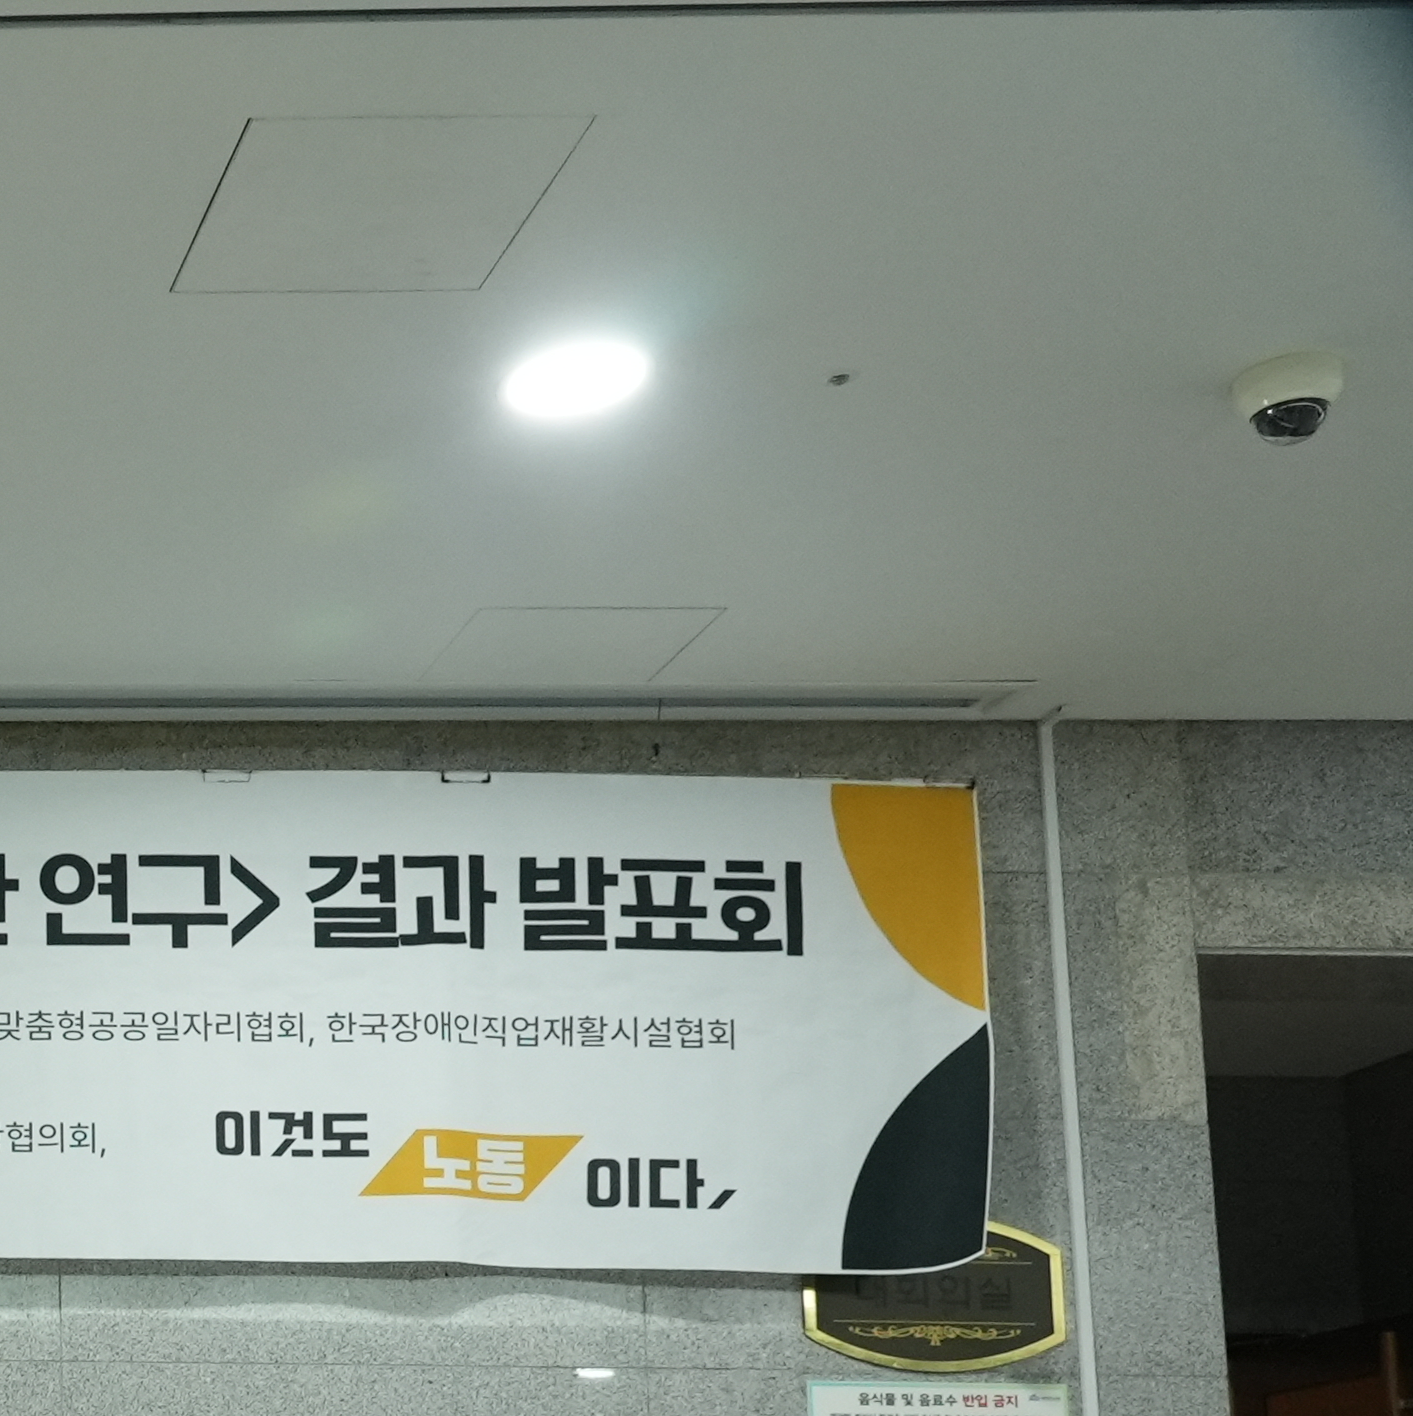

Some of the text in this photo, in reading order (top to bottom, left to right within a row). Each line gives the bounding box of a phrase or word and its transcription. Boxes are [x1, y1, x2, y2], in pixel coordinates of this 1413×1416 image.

[38, 855, 280, 949] 연구>
[305, 855, 497, 949] 결과
[519, 856, 804, 956] 발표회
[326, 1012, 736, 1051] 한국장애인직업재활시설협회
[215, 1110, 370, 1158] 이것도
[422, 1134, 526, 1196] 노동
[858, 1392, 897, 1407] 음식물
[903, 1393, 914, 1407] 및
[919, 1393, 958, 1407] 음료수
[962, 1394, 989, 1409] 반입
[993, 1394, 1020, 1409] 금지
